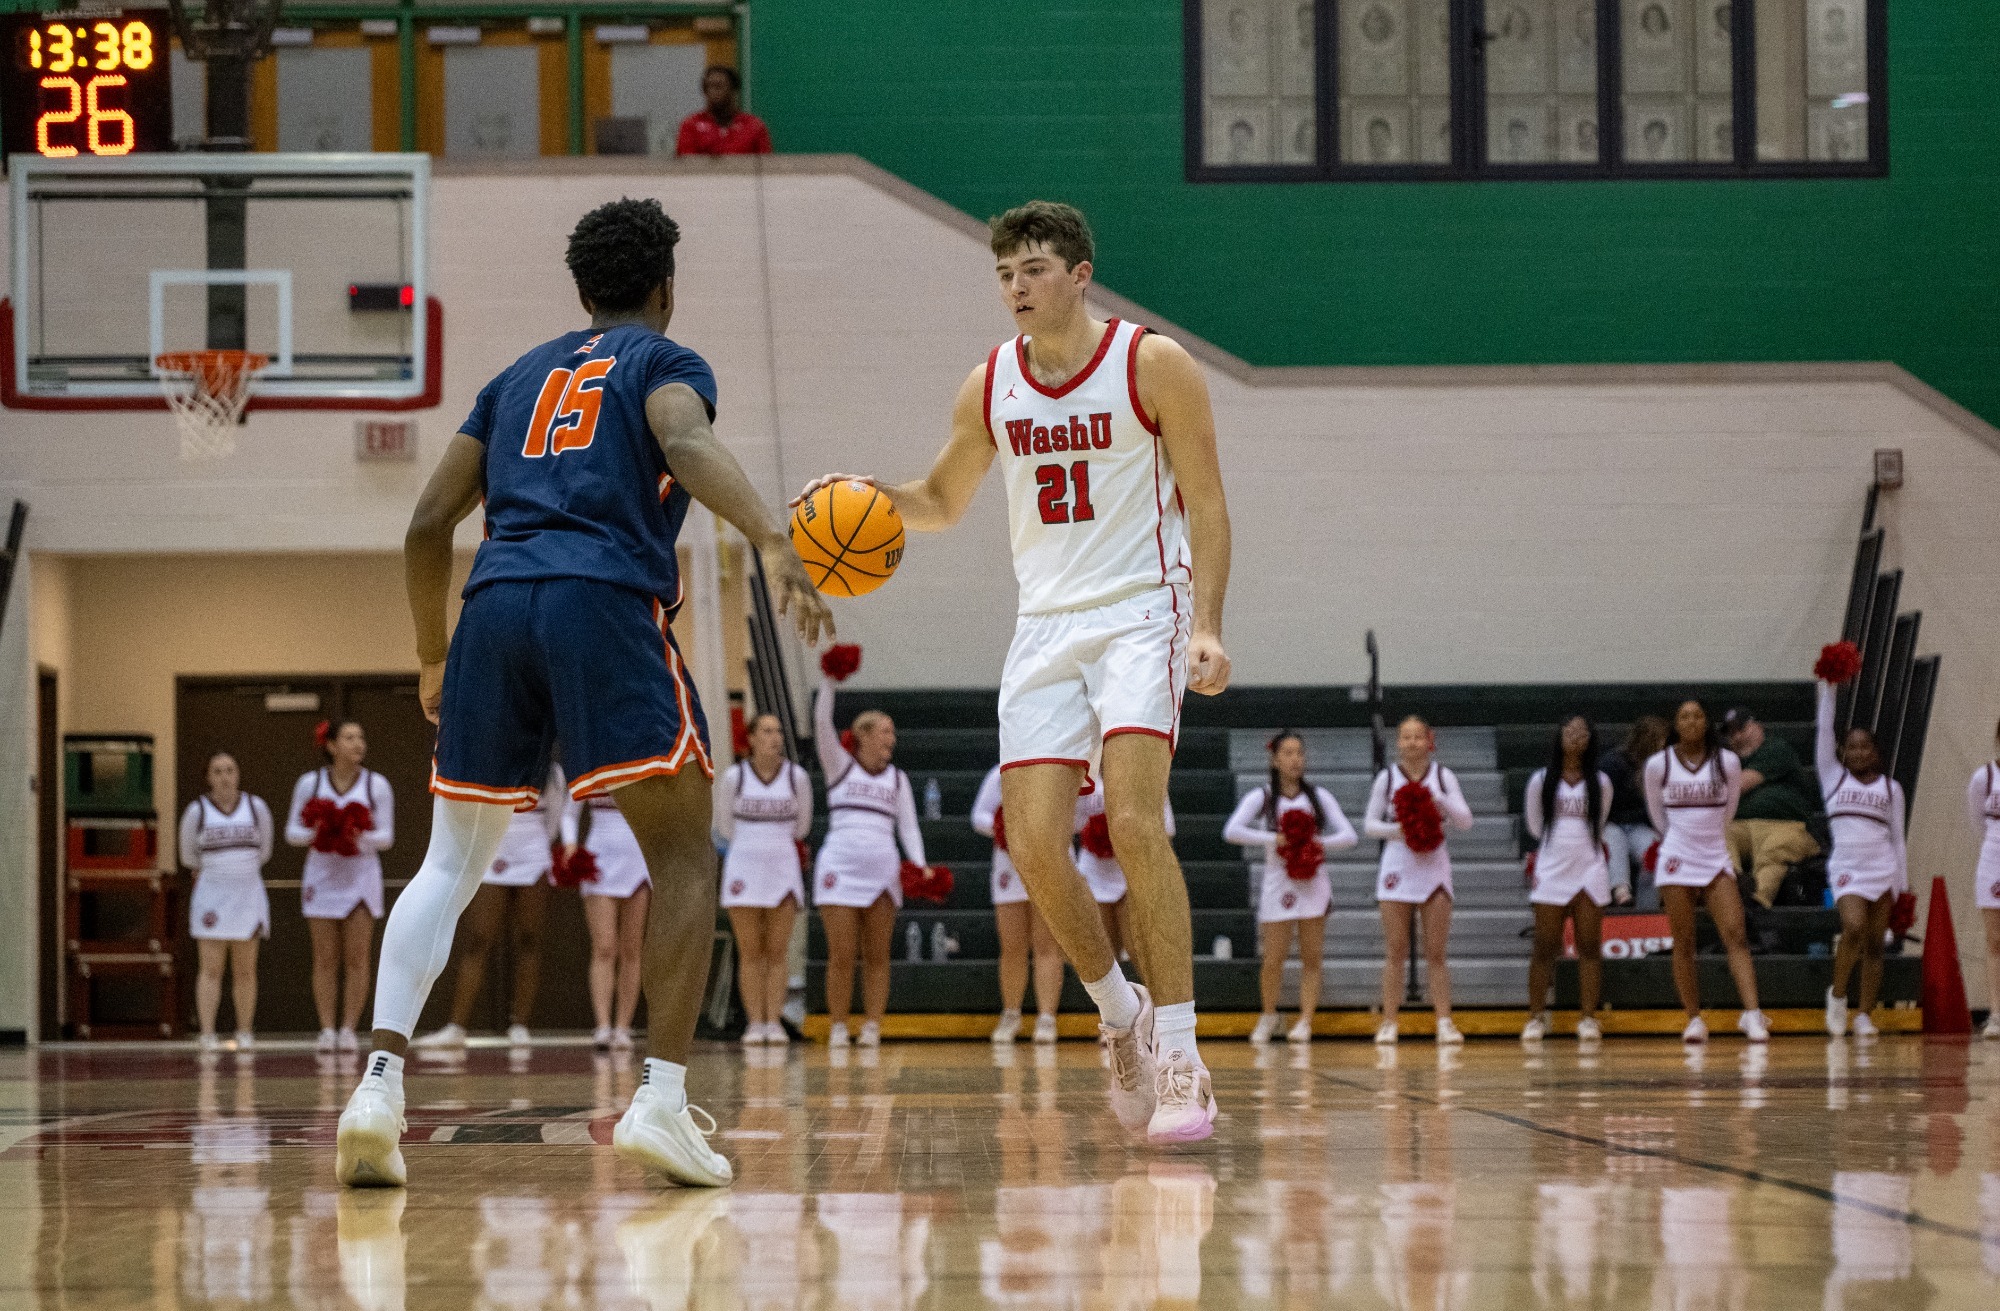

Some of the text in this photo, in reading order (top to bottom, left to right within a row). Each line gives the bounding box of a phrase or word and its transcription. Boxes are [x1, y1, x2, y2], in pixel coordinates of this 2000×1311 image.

[30, 21, 153, 72] 13:38
[37, 74, 135, 158] 26
[522, 355, 618, 458] 15
[1005, 412, 1112, 456] WashU
[1035, 460, 1095, 524] 21
